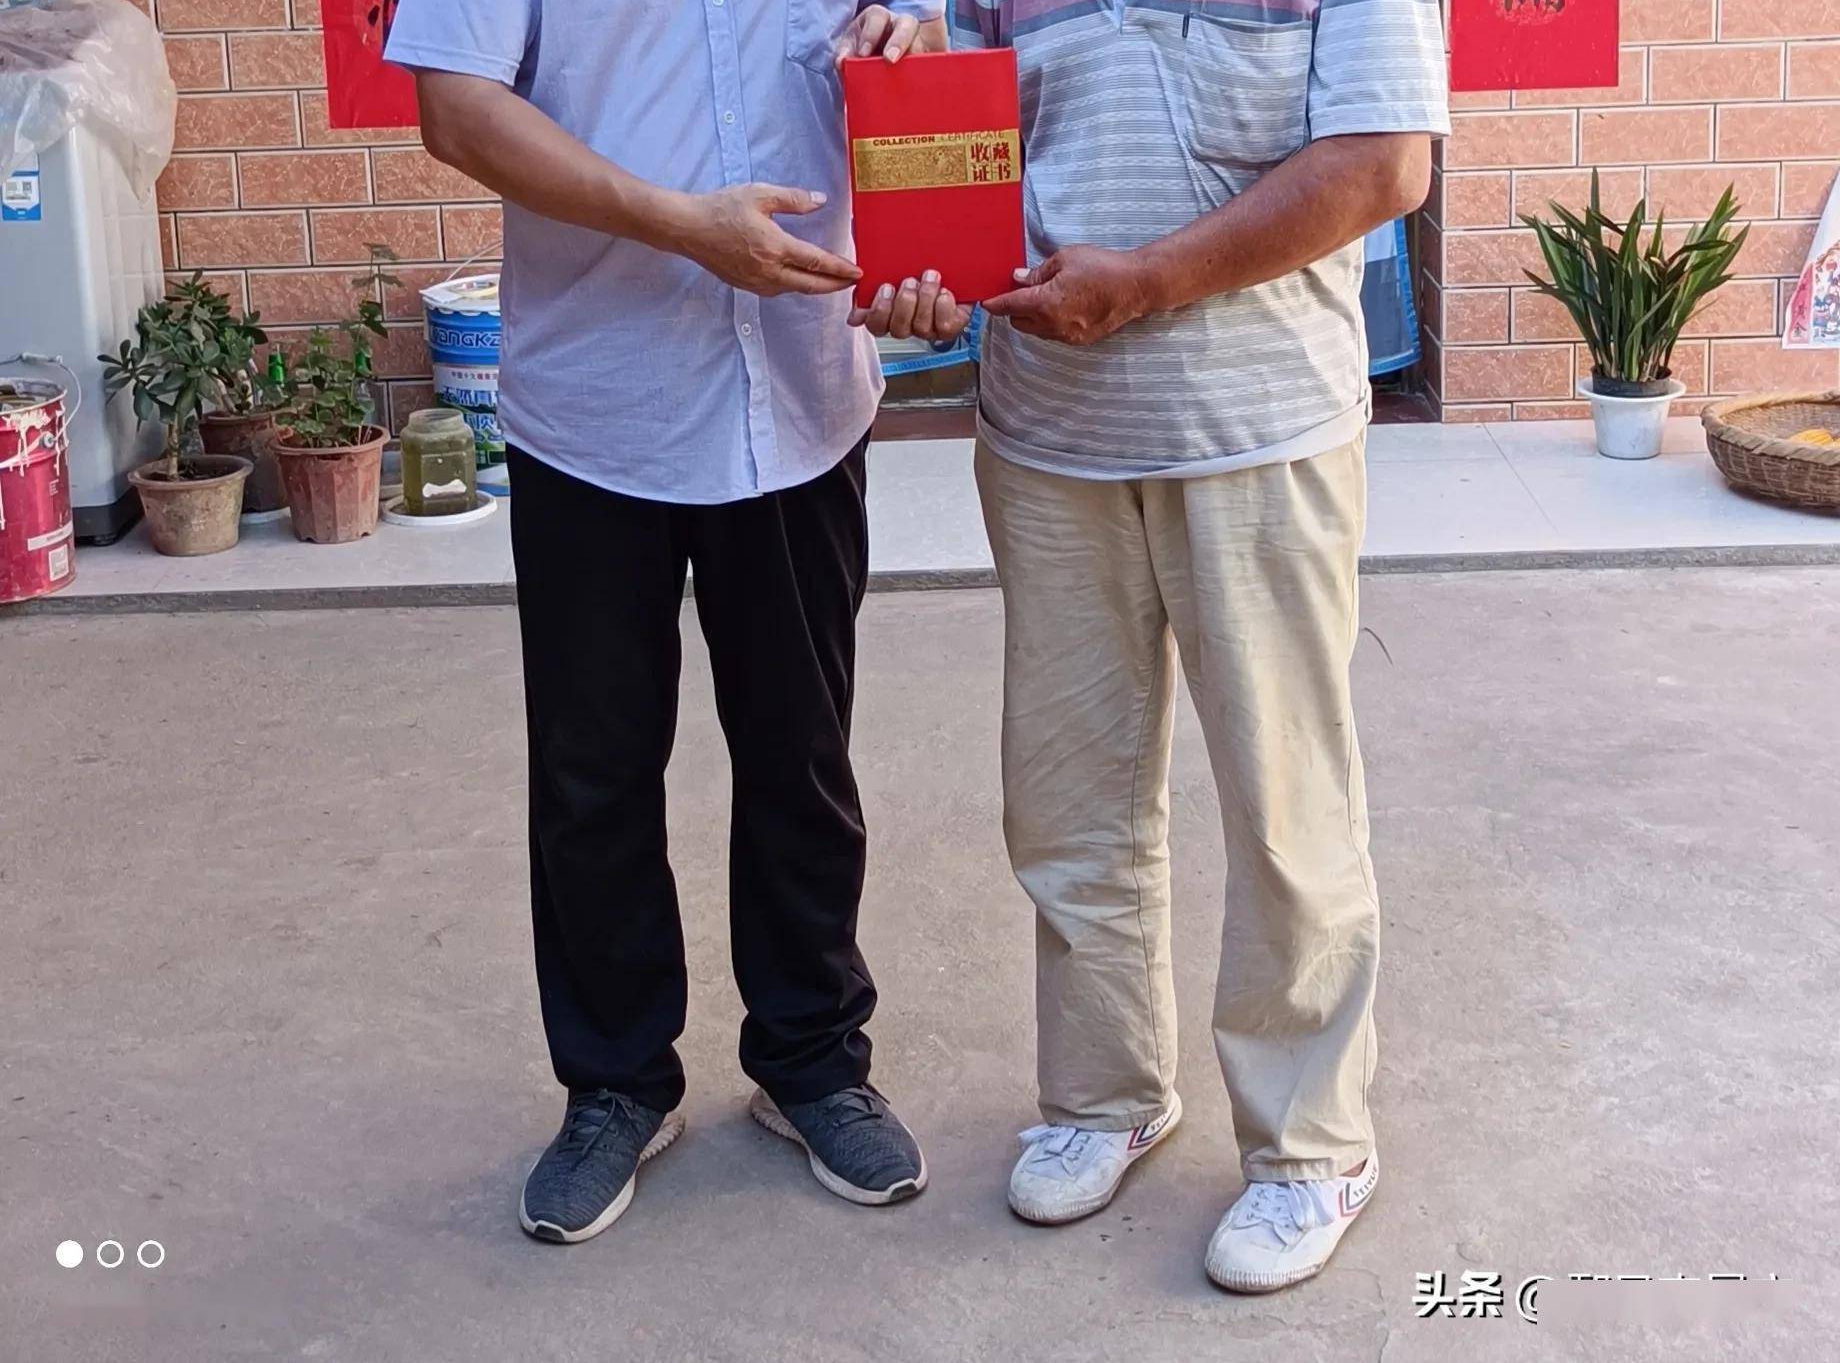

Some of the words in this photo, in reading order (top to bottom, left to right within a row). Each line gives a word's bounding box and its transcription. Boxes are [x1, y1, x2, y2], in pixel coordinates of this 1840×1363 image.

[872, 135, 936, 147] COLLECTION
[970, 141, 1011, 162] 收藏
[972, 163, 1011, 182] 证书
